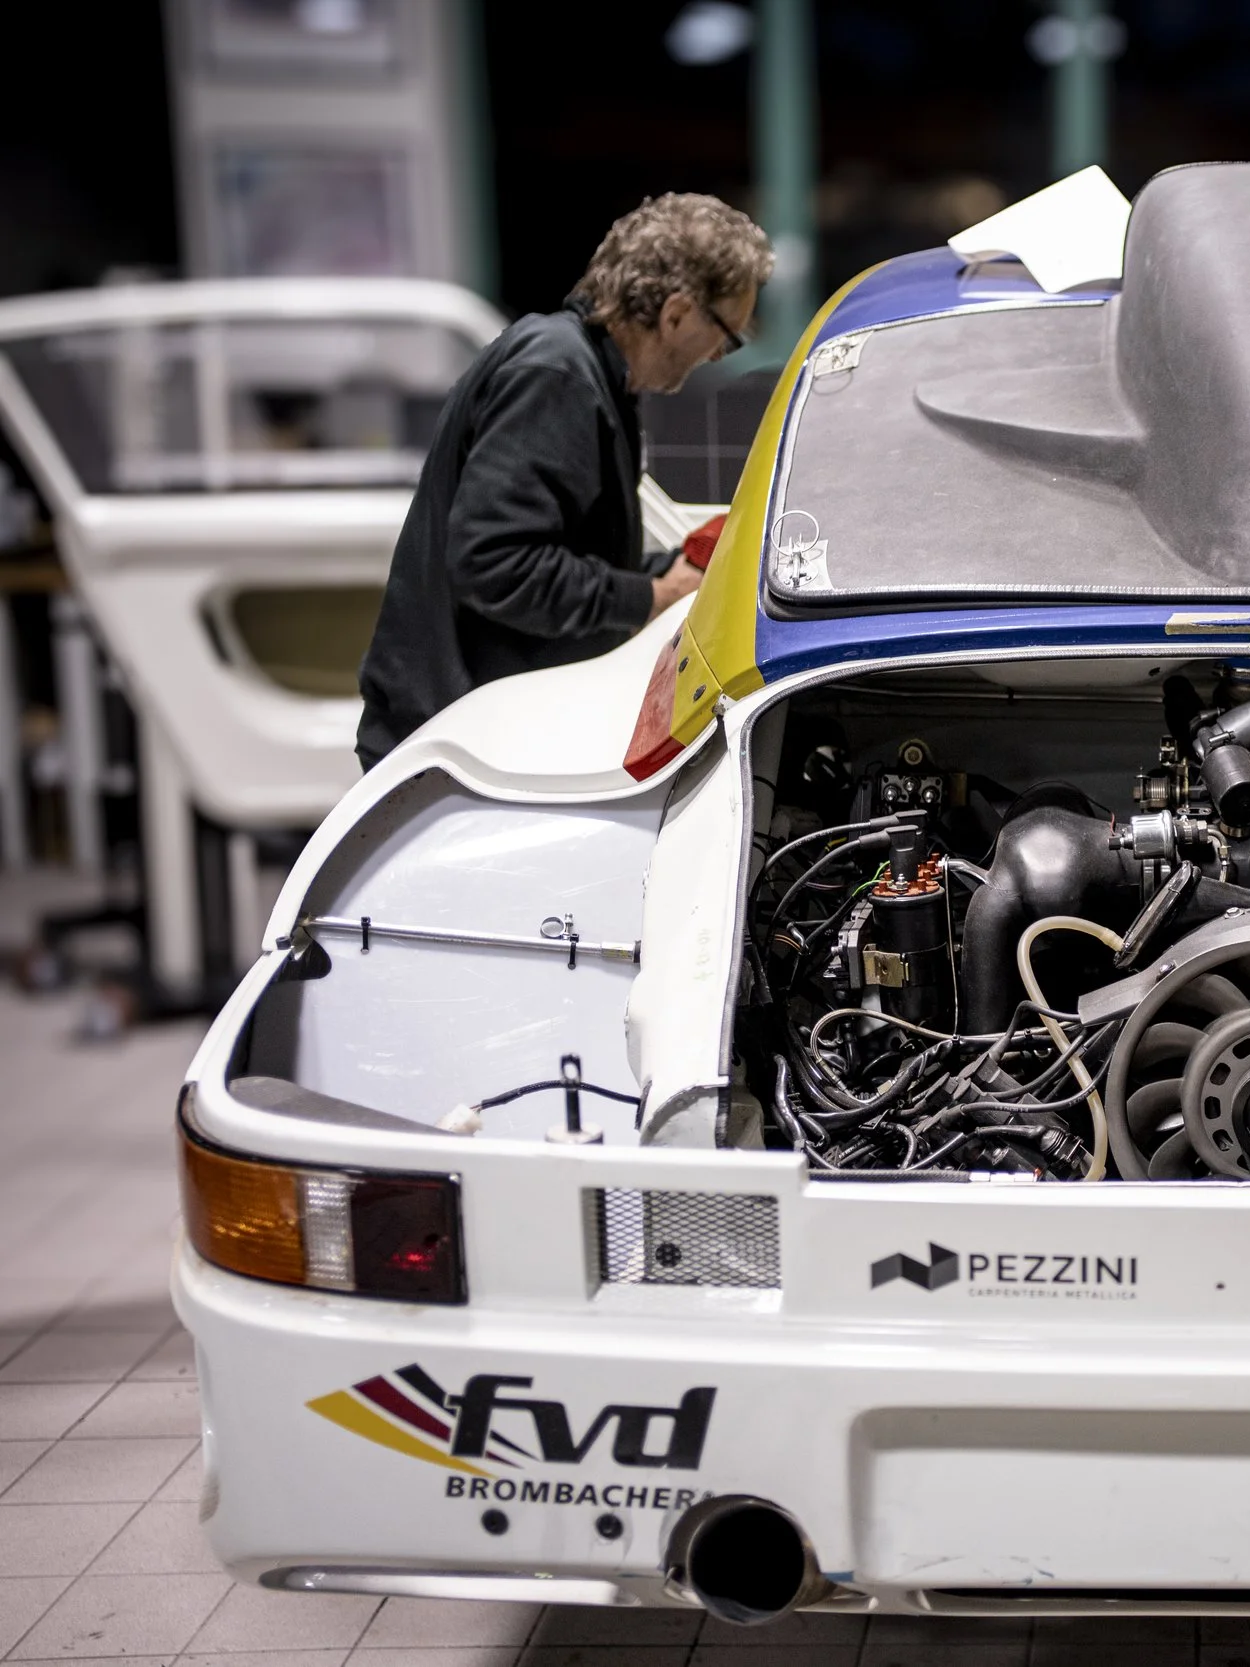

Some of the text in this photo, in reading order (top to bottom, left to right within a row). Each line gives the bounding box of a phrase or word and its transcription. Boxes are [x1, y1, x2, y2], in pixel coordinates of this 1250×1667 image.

[968, 1253, 1138, 1285] PEZZINI
[968, 1287, 1137, 1301] CARPENTERIA METALLICA
[446, 1374, 717, 1470] fvd
